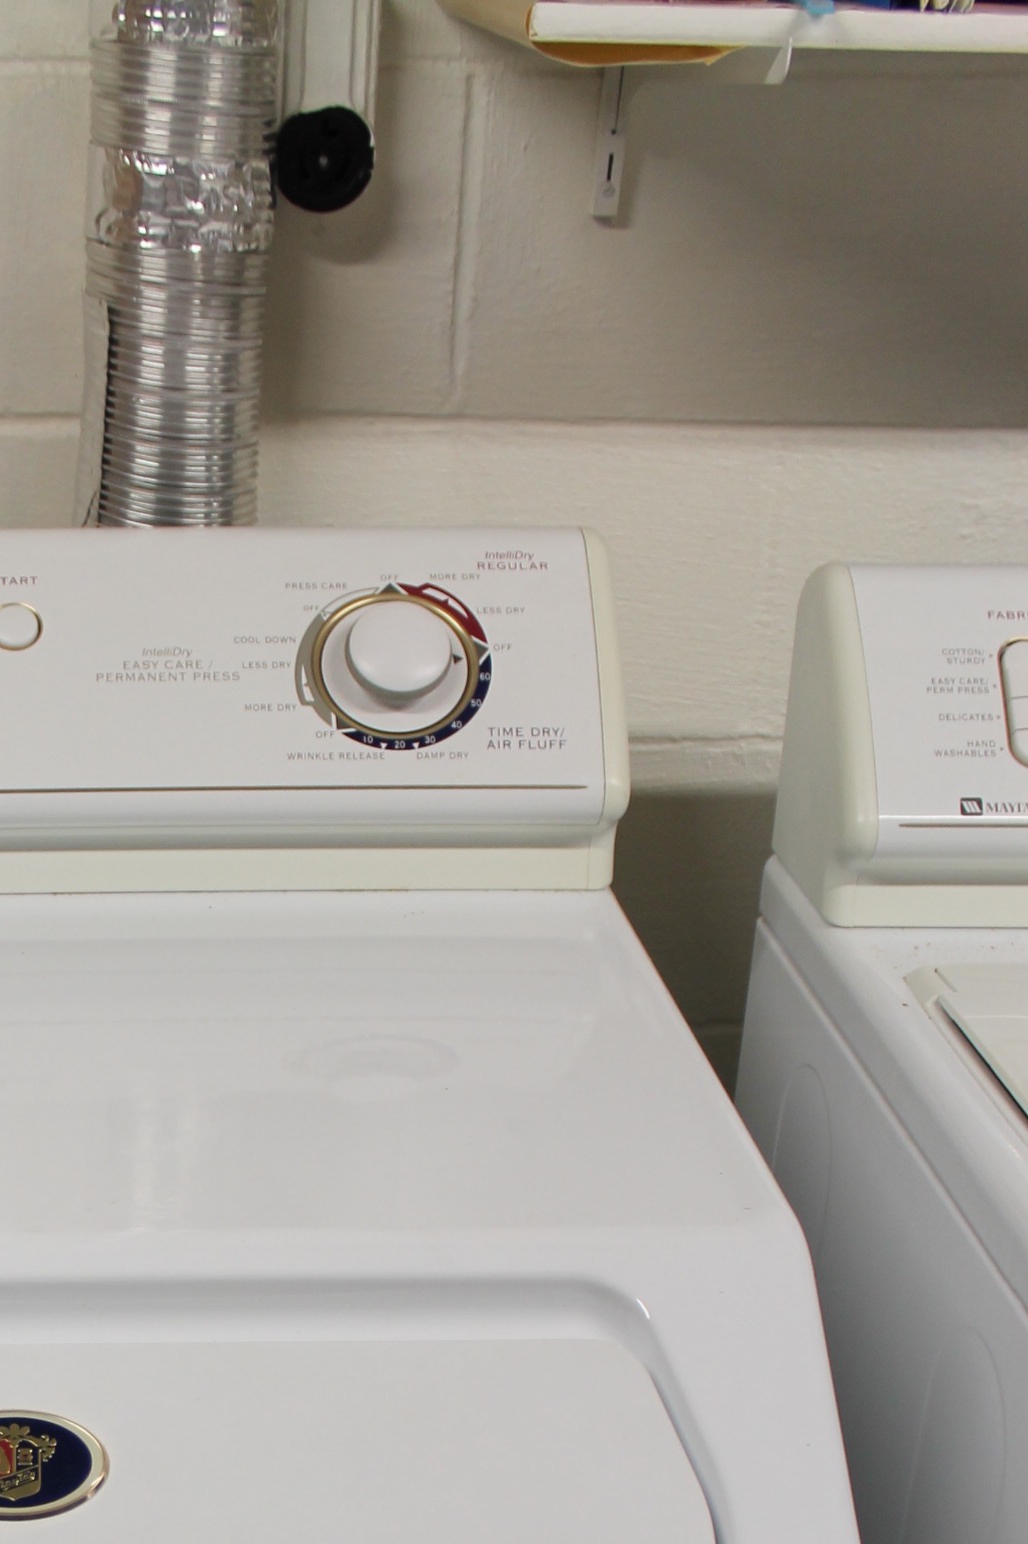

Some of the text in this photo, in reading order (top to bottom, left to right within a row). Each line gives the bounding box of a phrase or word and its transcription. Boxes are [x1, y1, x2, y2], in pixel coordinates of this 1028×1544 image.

[477, 561, 548, 571] REGULAR
[380, 574, 399, 582] OFF
[429, 573, 481, 581] MORE DRY
[284, 581, 348, 590] PRESS CARE
[303, 604, 320, 612] OFF
[476, 606, 525, 615] LESS DRY
[987, 610, 1028, 620] FABR
[233, 635, 297, 644] COOL DOWN
[493, 643, 512, 651] OFF
[141, 647, 193, 658] IntelliDry
[123, 660, 159, 670] EASY
[164, 660, 203, 670] CARE
[242, 660, 292, 669] LESS DRY
[96, 671, 241, 682] PERMANENT PRESS
[479, 671, 491, 681] 60
[931, 677, 956, 685] EASY
[926, 686, 990, 694] PERM PRESS
[470, 698, 482, 707] 50
[244, 703, 297, 712] MORE DRY
[938, 713, 994, 722] DELICATES
[451, 720, 463, 730] 40
[315, 731, 335, 739] OFF
[487, 726, 566, 738] TIME DRY/
[362, 735, 374, 744] 10
[424, 734, 436, 744] 30
[394, 739, 406, 749] 20
[486, 738, 568, 750] AIR FLUFF
[967, 740, 996, 748] HAND
[287, 751, 385, 761] WRINKLE RELEASE
[416, 751, 470, 760] DAMP DRY
[934, 749, 997, 758] WASHABLES
